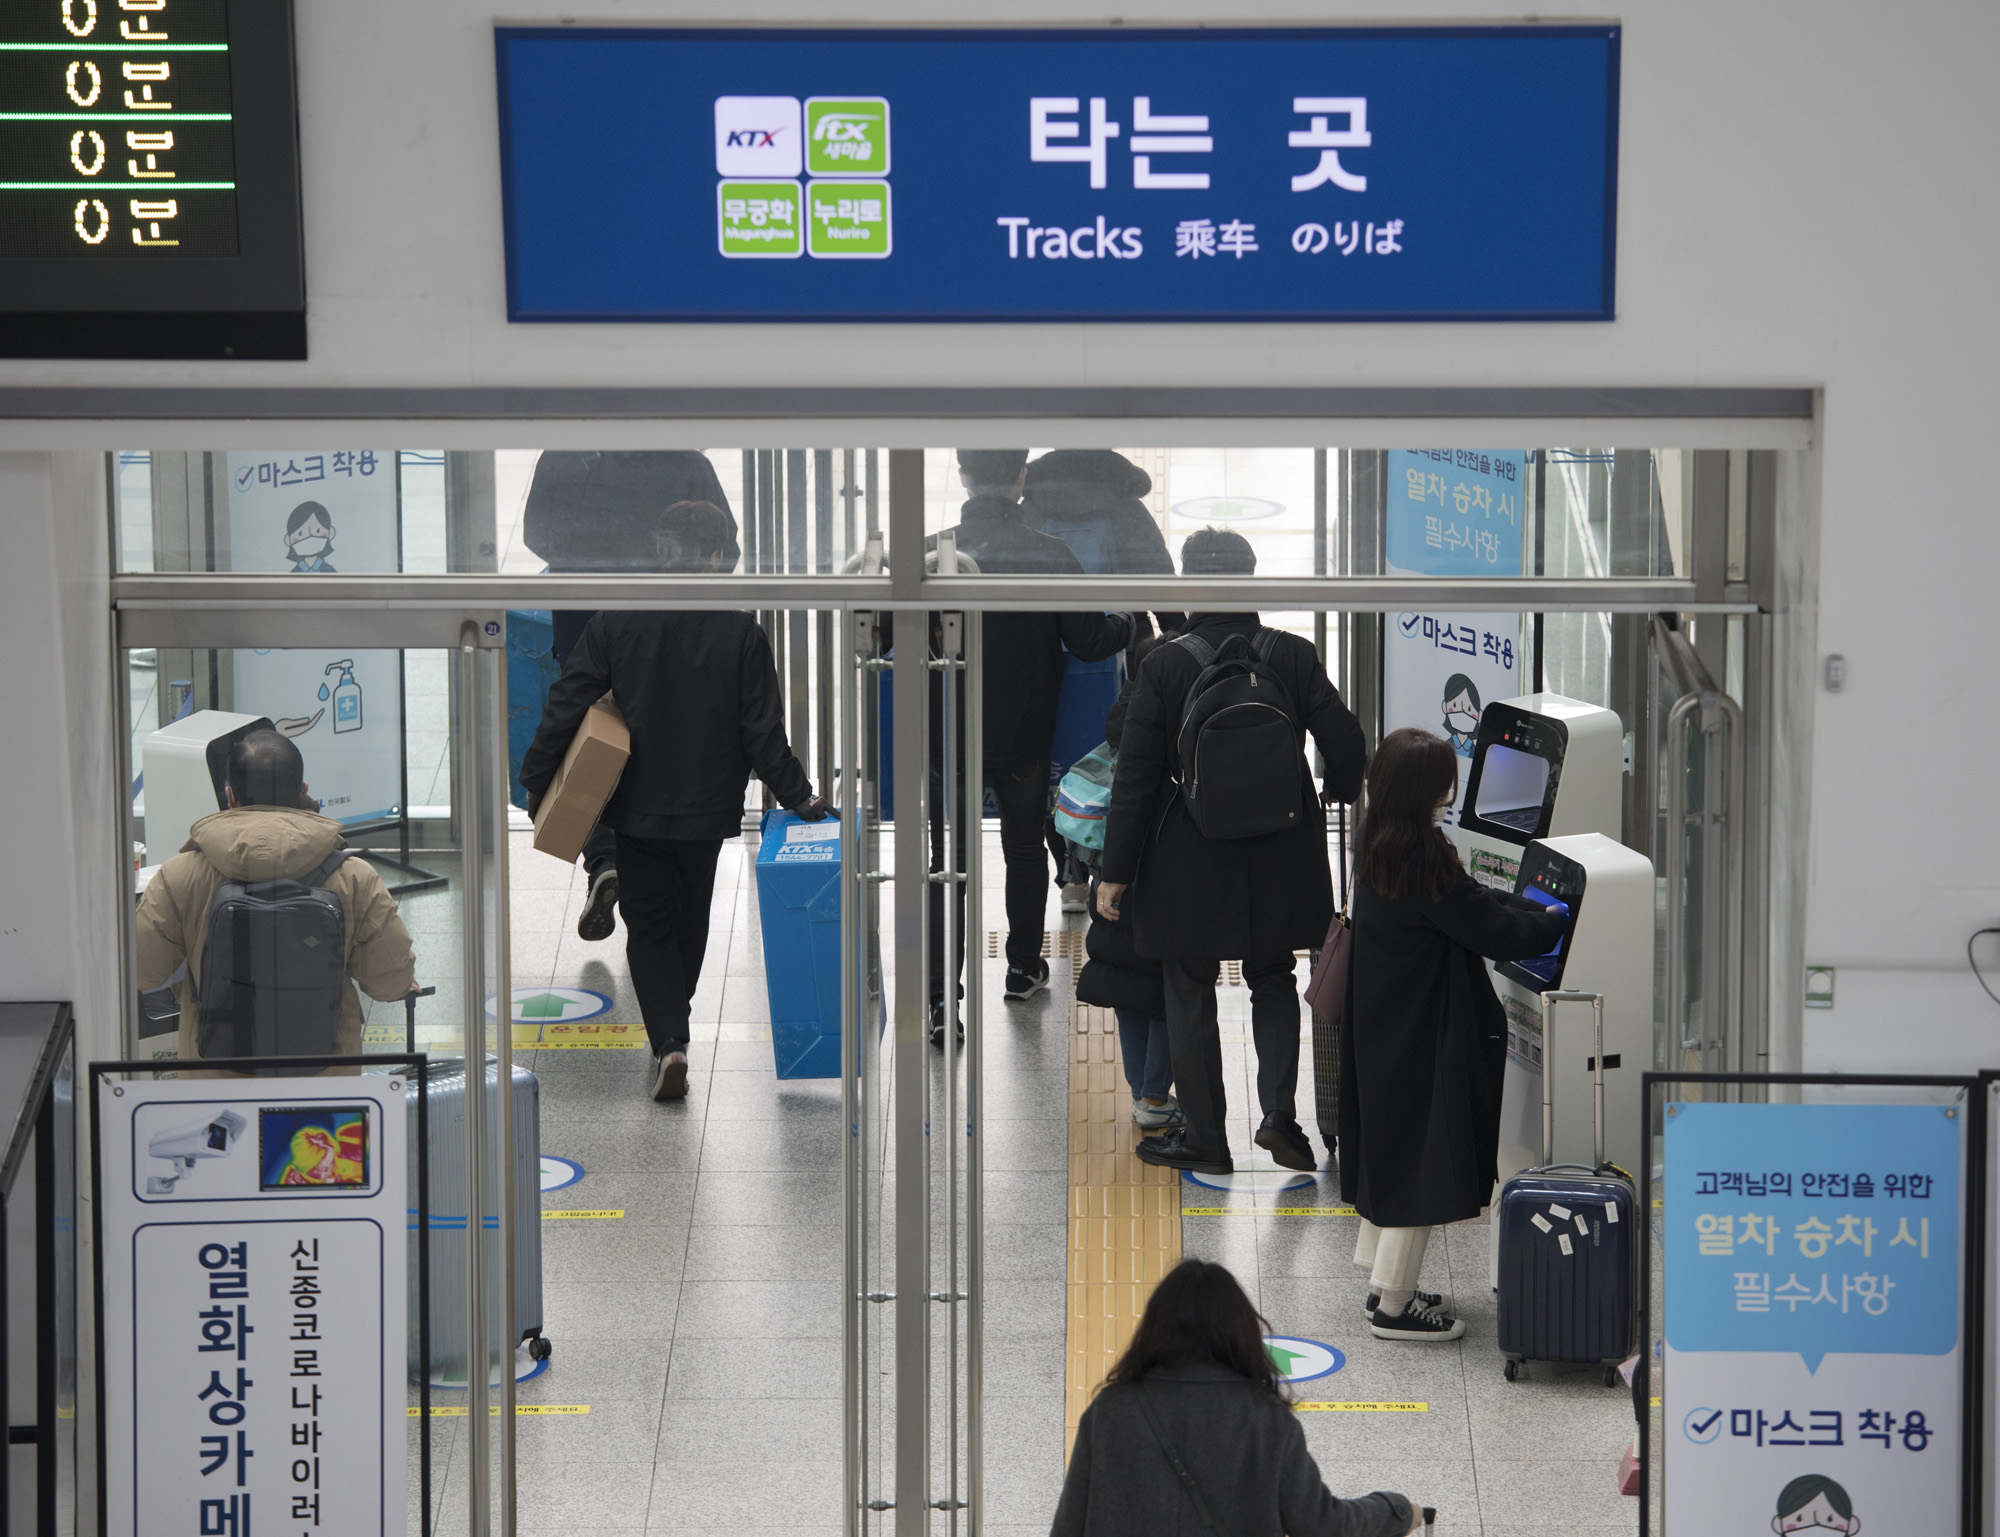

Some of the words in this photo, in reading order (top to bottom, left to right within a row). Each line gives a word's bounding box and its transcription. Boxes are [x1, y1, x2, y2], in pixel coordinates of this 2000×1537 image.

[726, 126, 786, 148] KTX
[823, 140, 873, 161] 새마을
[1029, 96, 1214, 189] 타는
[1288, 96, 1373, 192] 곳
[724, 198, 795, 226] 무궁화
[814, 198, 883, 226] 누리로
[724, 227, 795, 242] Mugunghwa
[826, 225, 871, 240] Nuriro
[996, 215, 1144, 259] Tracks
[1290, 218, 1405, 257] のりば
[257, 454, 326, 489] 마스크
[332, 449, 380, 477] 착용
[1456, 448, 1491, 475] 안전을
[1493, 457, 1517, 482] 위한
[1406, 467, 1447, 508] 열차
[1452, 481, 1493, 519] 승차
[1497, 492, 1515, 527] 시
[1424, 515, 1501, 564] 필수사항
[487, 623, 498, 635] 21
[1422, 616, 1477, 657] 마스크
[1482, 631, 1515, 671] 착용
[778, 843, 818, 853] KTX
[1695, 1172, 1793, 1197] 고객님의
[1801, 1173, 1875, 1198] 안전을
[1883, 1173, 1934, 1199] 위한
[1695, 1212, 1781, 1257] 열차
[1793, 1213, 1879, 1259] 승차
[1889, 1216, 1930, 1259] 시
[1733, 1271, 1896, 1316] 필수사항
[289, 1238, 323, 1537] 신종코로나바이러
[1730, 1408, 1844, 1448] 마스크
[1858, 1408, 1934, 1452] 착용
